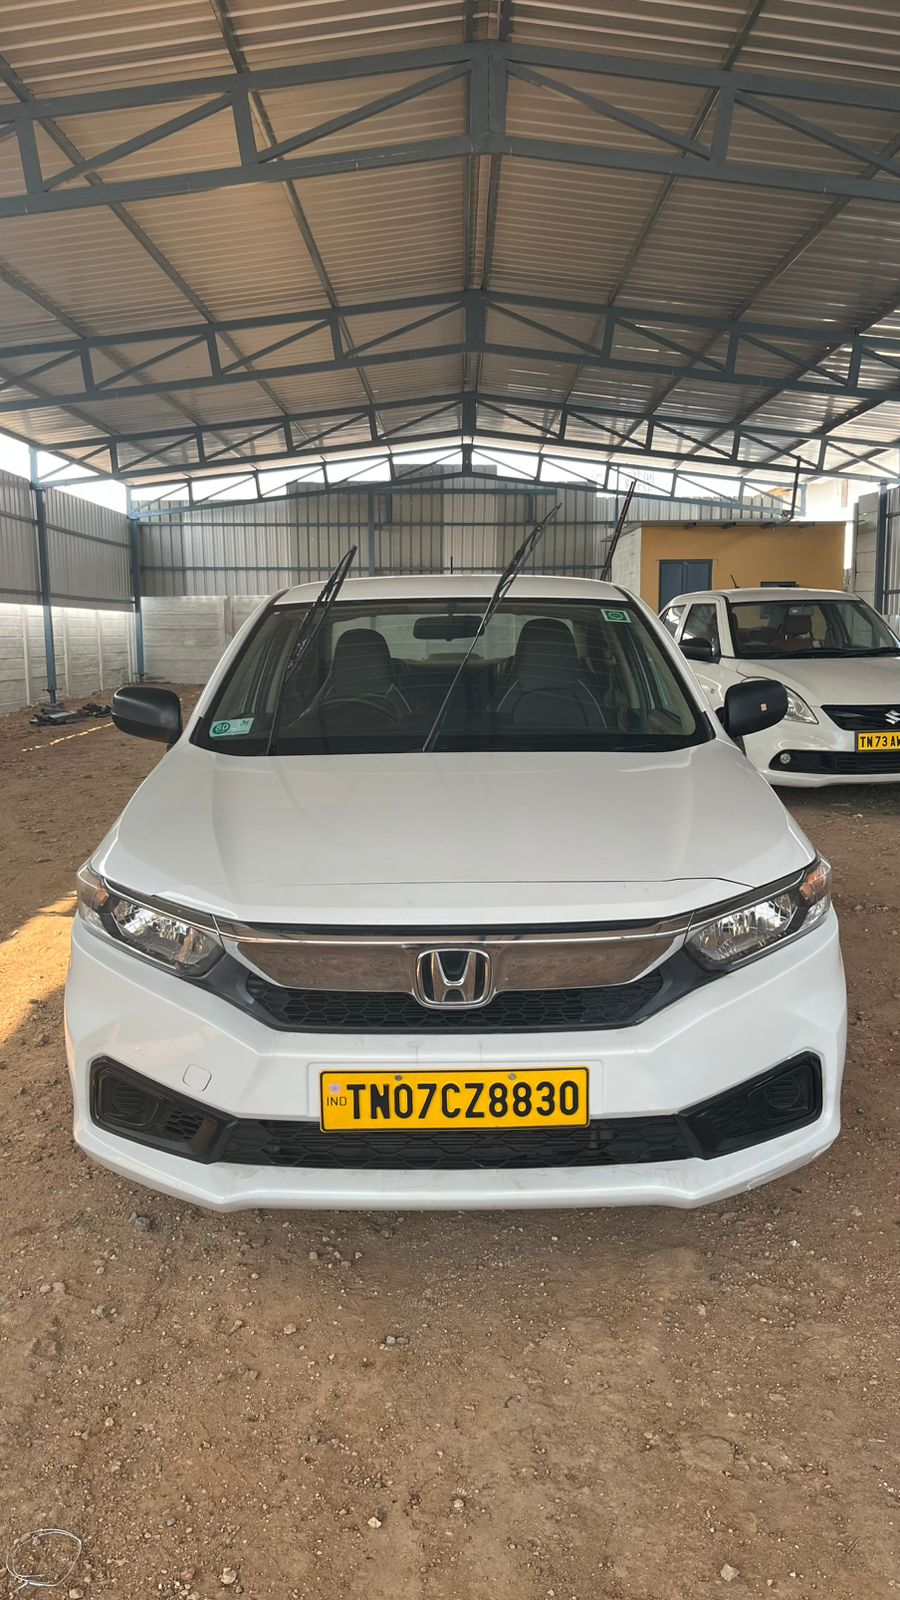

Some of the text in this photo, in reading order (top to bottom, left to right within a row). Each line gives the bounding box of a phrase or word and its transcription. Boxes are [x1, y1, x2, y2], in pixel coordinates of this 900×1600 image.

[860, 736, 873, 748] TN
[875, 736, 888, 748] 73
[326, 1096, 347, 1106] IND
[346, 1080, 579, 1120] TN07CZ8830
